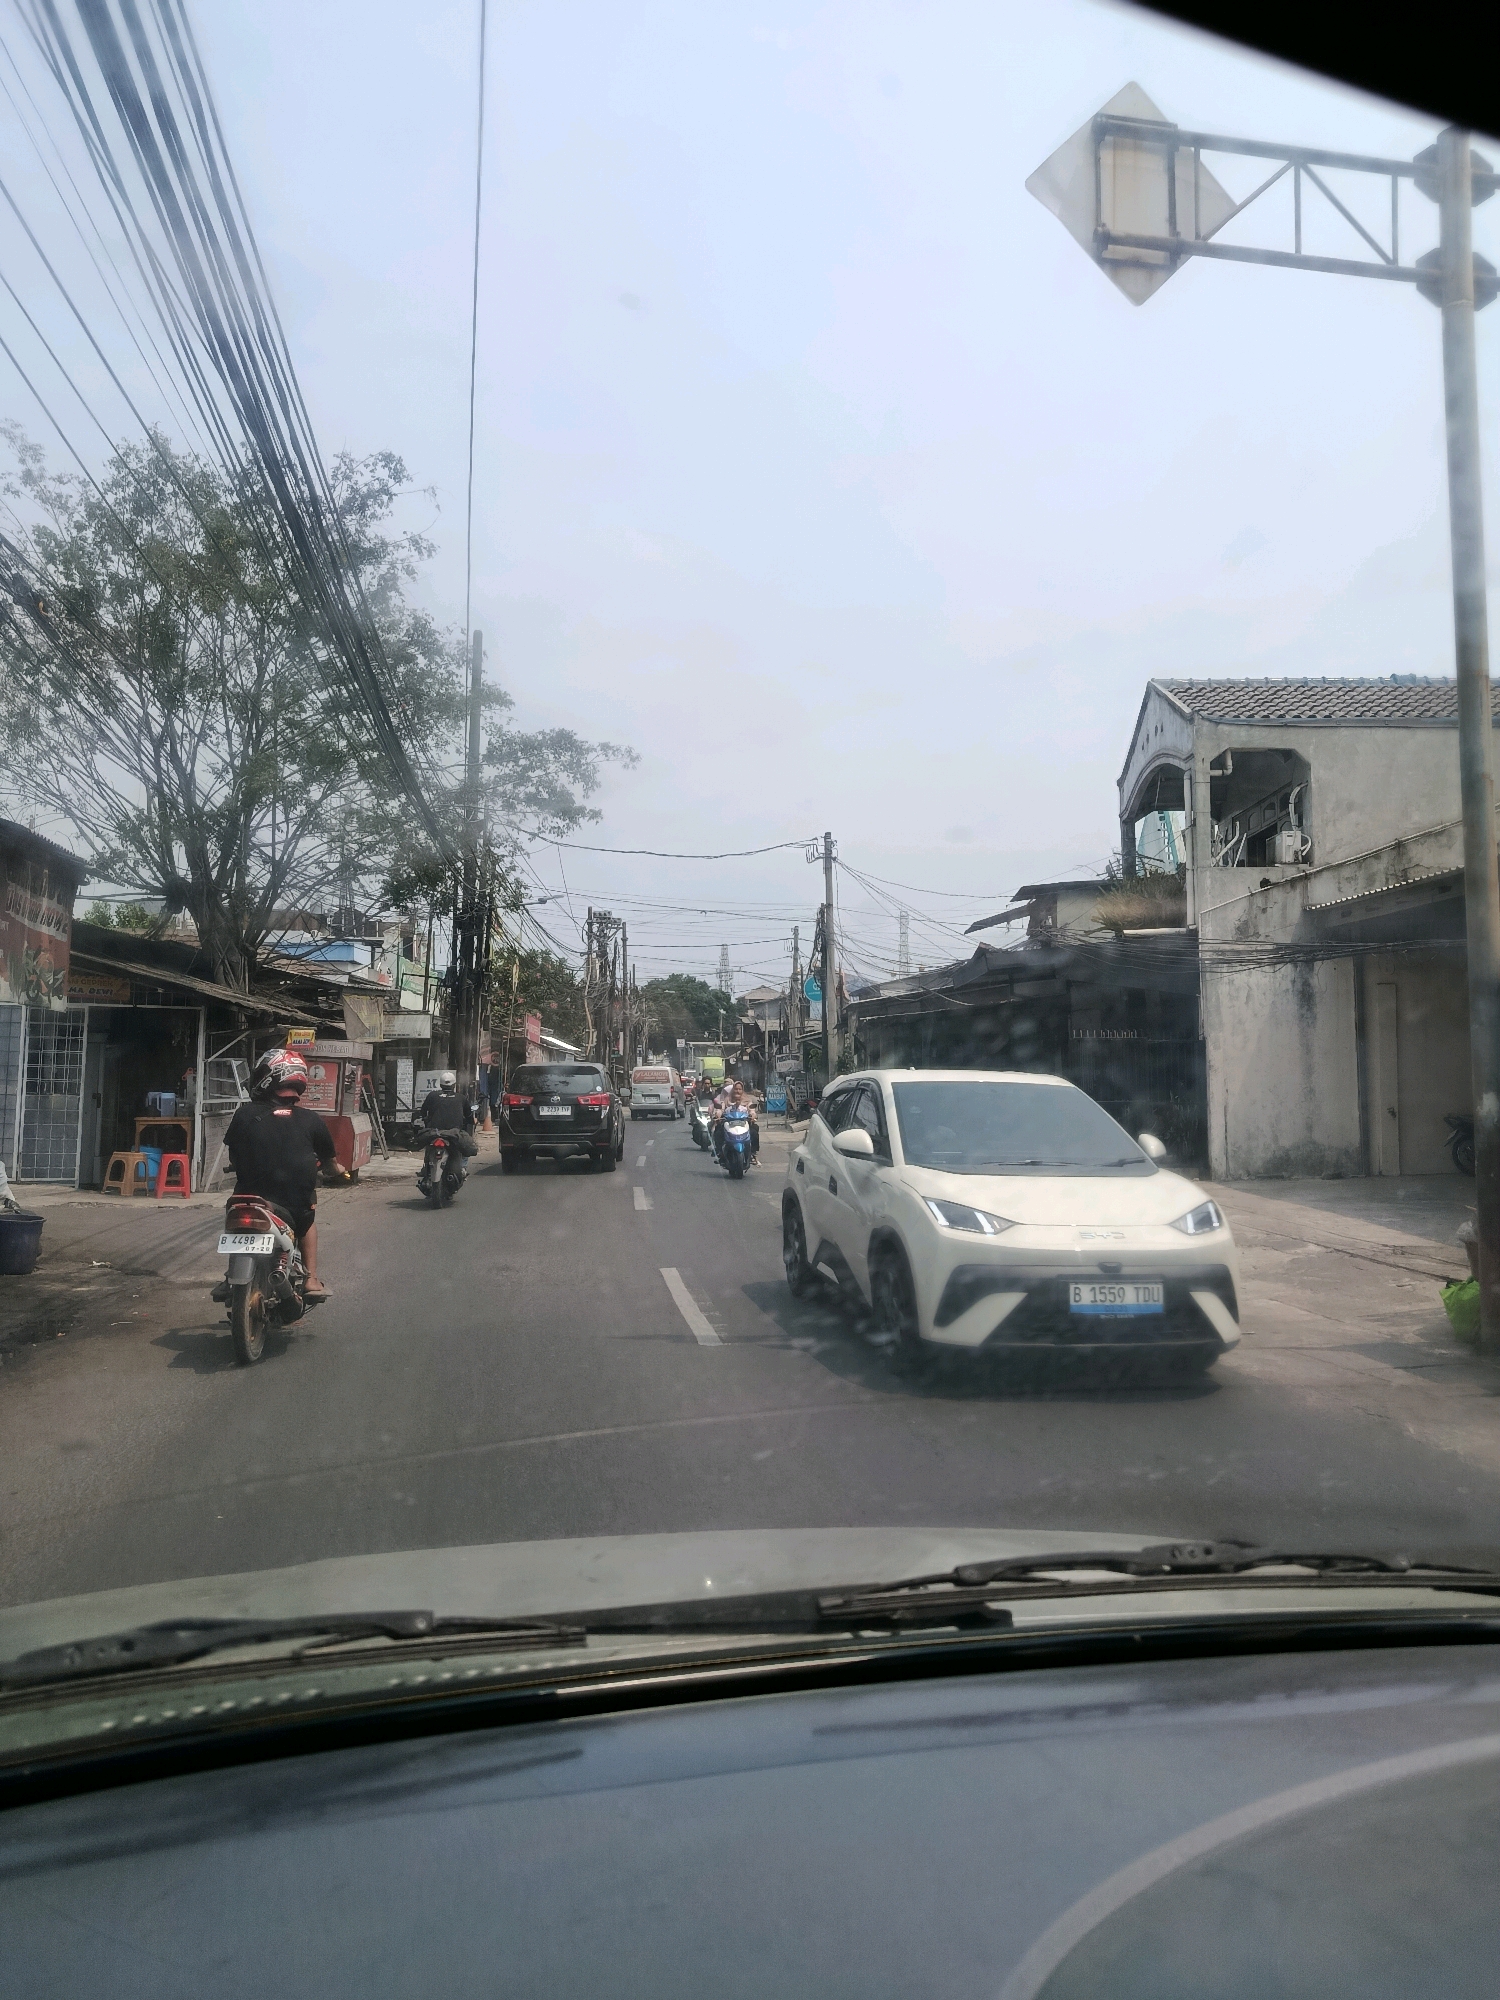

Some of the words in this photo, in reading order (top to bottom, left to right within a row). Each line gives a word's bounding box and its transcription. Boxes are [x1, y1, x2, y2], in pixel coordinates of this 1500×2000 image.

[220, 1236, 228, 1245] B
[231, 1235, 256, 1245] 4498
[1079, 1231, 1126, 1239] BYD
[1073, 1286, 1083, 1304] B
[1089, 1285, 1126, 1304] 1559
[1133, 1286, 1160, 1303] TDU
